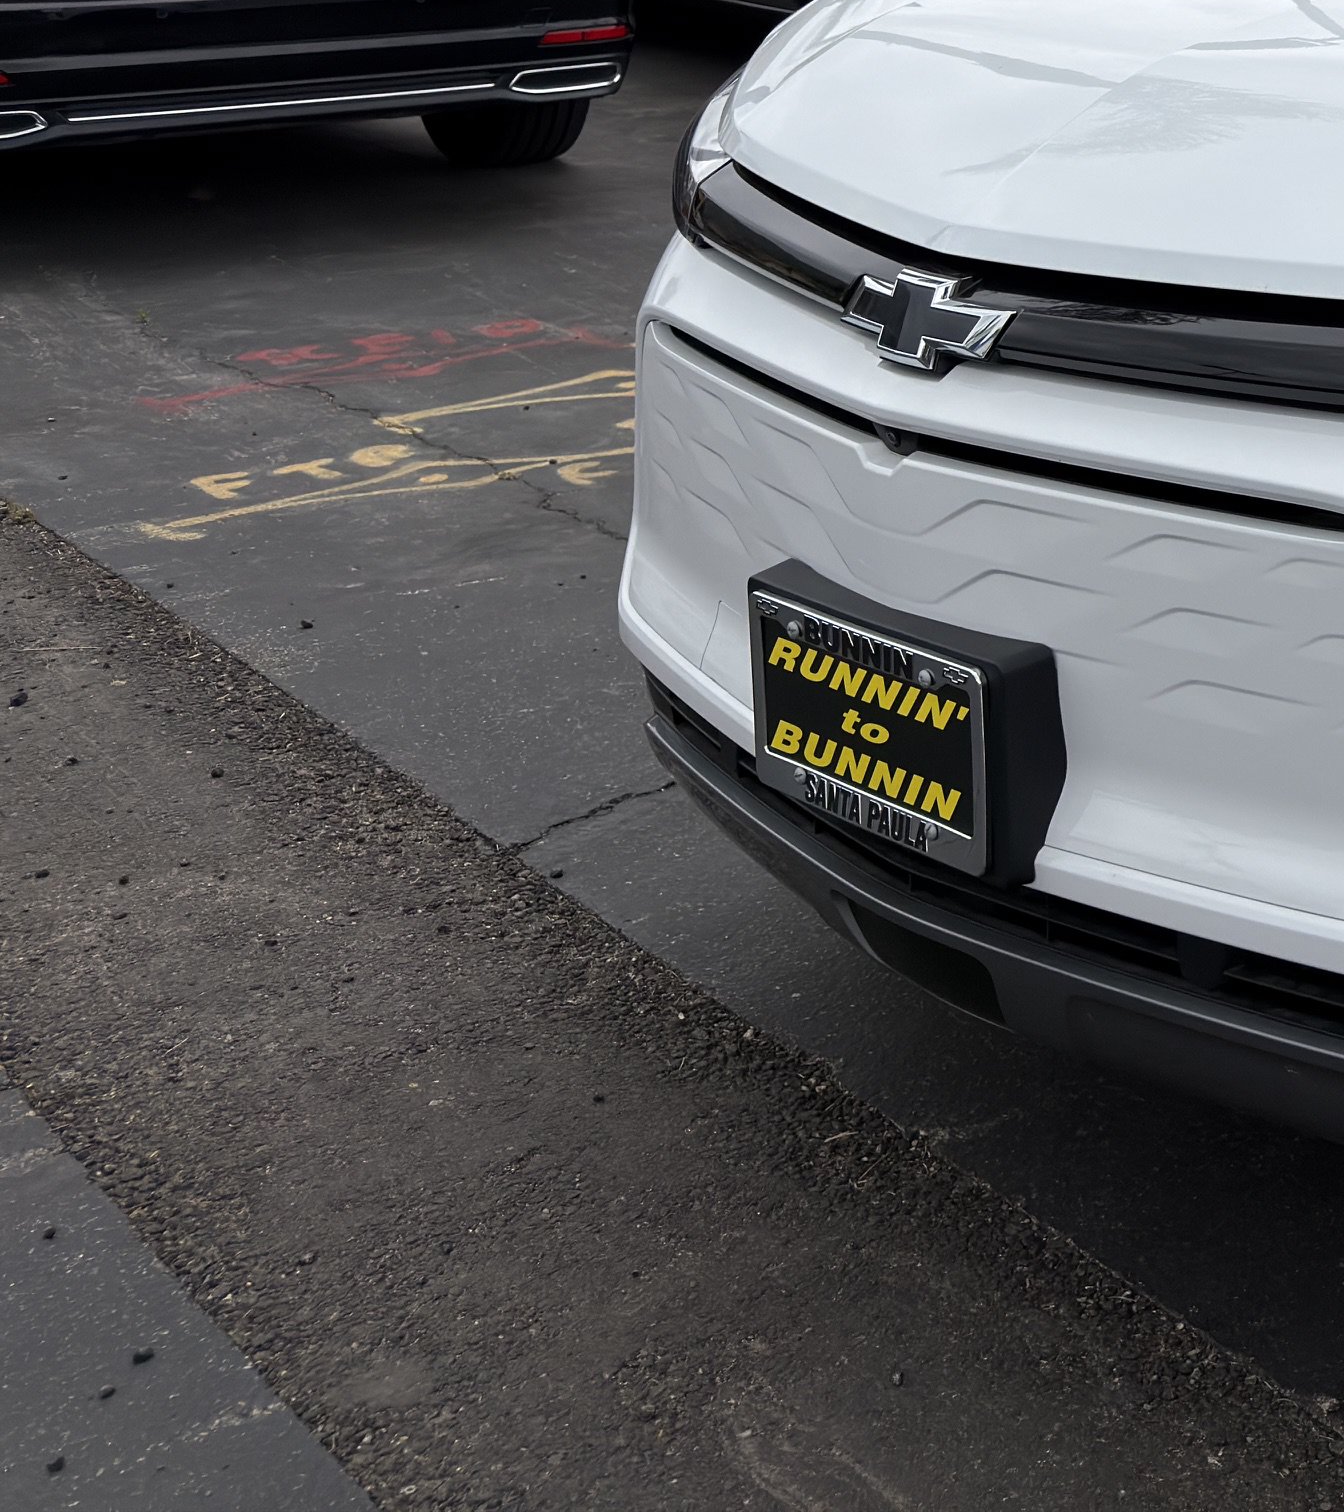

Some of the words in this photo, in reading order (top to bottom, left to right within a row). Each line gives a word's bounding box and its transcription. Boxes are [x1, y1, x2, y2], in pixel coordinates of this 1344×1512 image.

[768, 636, 970, 731] RUNNIN'
[803, 613, 914, 678] BUNNIN
[841, 707, 890, 745] to
[770, 719, 962, 822] BUNNIN
[804, 772, 863, 824] SANTA
[866, 800, 930, 853] PAULA
